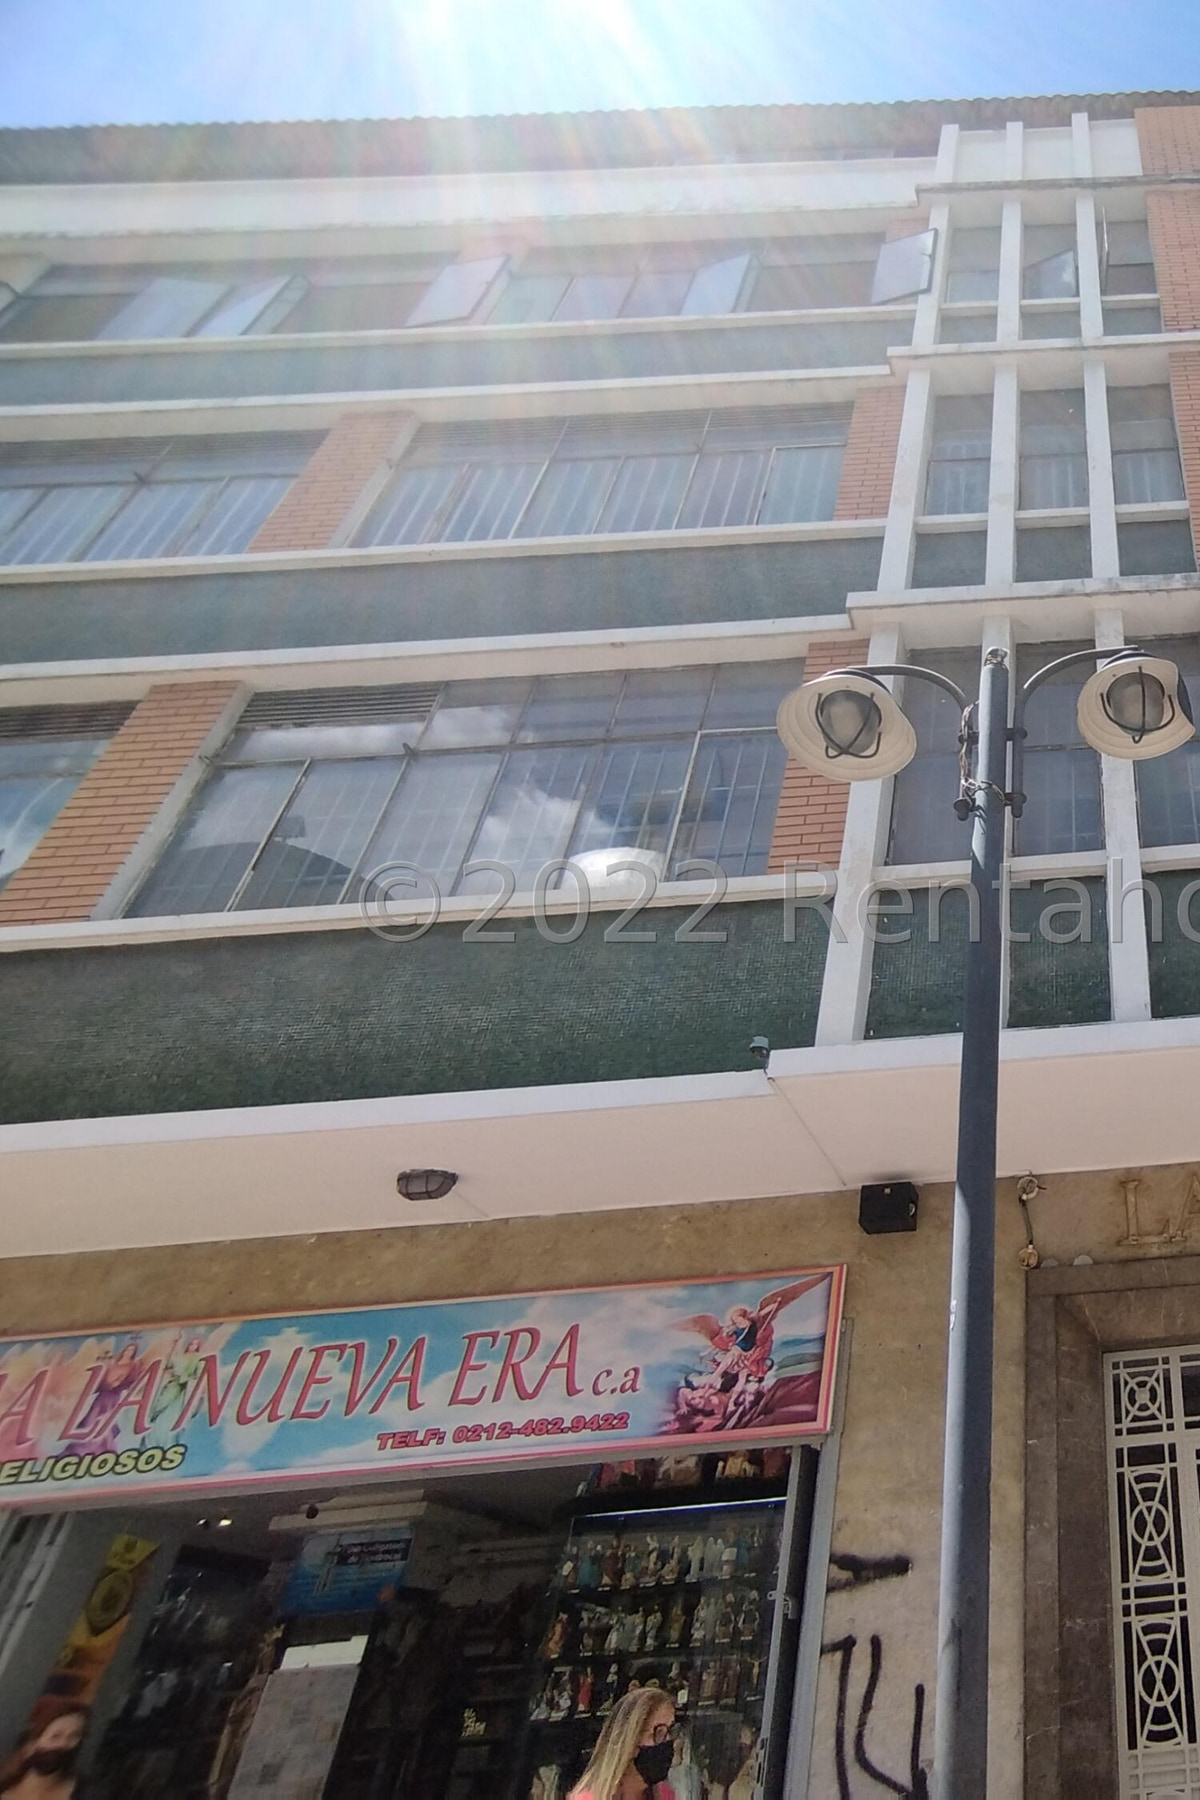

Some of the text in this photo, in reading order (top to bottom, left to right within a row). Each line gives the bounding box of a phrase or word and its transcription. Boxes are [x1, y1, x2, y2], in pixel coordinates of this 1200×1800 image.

[59, 1357, 162, 1442] LA
[171, 1337, 426, 1432] NUEVA
[448, 1323, 584, 1407] ERA
[591, 1366, 640, 1397] c.a
[377, 1411, 631, 1451] TELF: 0212-482.9422
